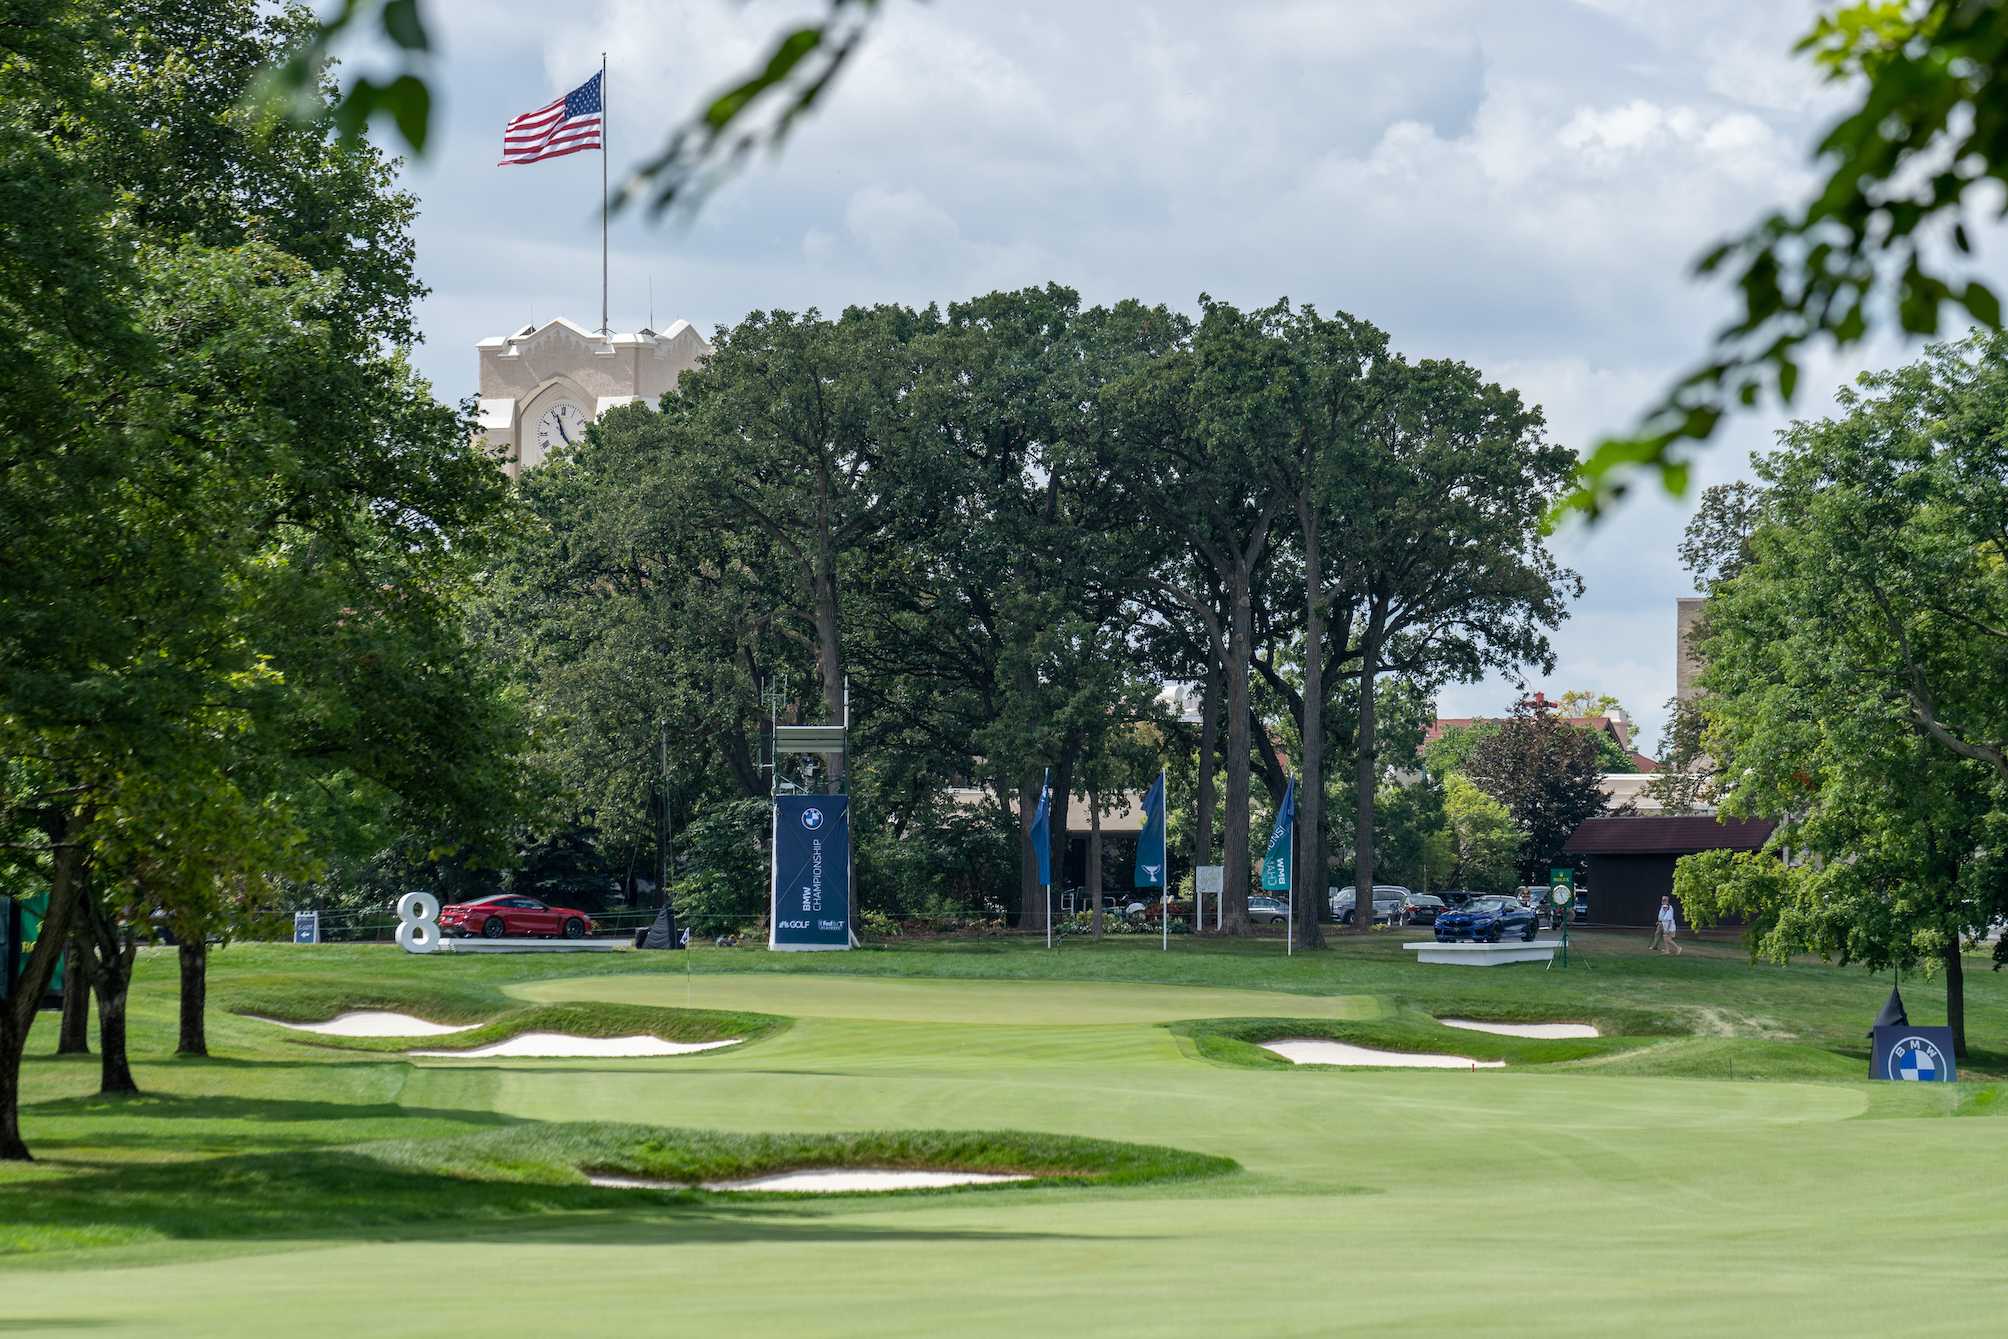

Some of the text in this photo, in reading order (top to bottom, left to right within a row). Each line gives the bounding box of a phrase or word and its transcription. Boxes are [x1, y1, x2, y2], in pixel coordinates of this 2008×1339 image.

[812, 838, 822, 911] CHAMPIONSHIP
[802, 886, 811, 912] BMW
[395, 892, 440, 953] 8
[790, 920, 810, 929] GOLF
[1895, 1040, 1937, 1058] BMW
